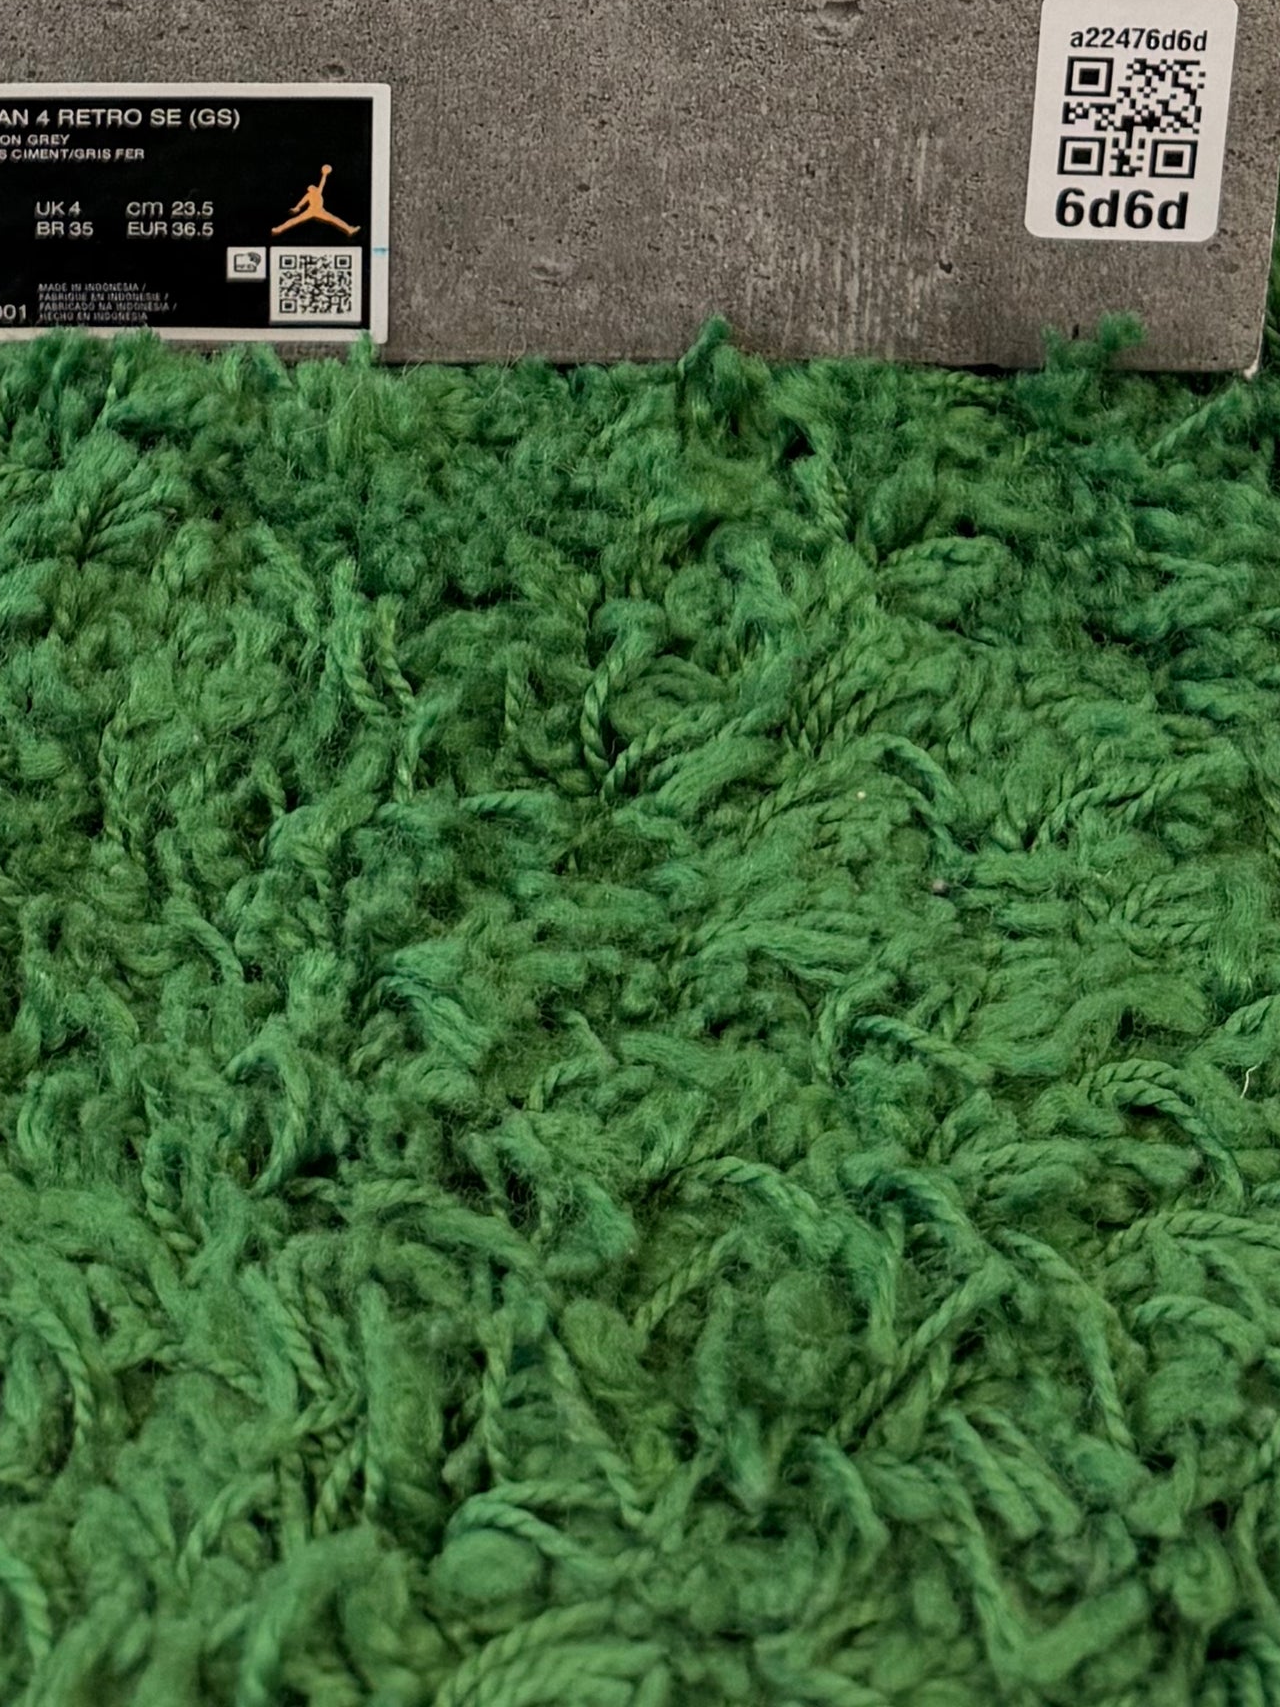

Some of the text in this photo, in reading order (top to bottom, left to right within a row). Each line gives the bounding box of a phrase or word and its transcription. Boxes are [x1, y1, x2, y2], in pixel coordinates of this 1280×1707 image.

[1070, 27, 1207, 51] a22476d6d
[36, 110, 50, 127] 4
[58, 109, 142, 127] RETRO
[150, 108, 182, 126] SE
[189, 108, 240, 129] (GS)
[28, 134, 70, 145] GREY
[12, 149, 111, 160] CIMENT/GRIS
[116, 148, 145, 159] FER
[36, 201, 81, 216] UK 4
[127, 201, 214, 216] cm 23.5
[1055, 187, 1189, 230] 6d6d
[36, 222, 94, 236] BR 35
[127, 222, 214, 237] EUR 36.5
[38, 283, 68, 291] MADE
[71, 283, 81, 291] IN
[85, 283, 139, 291] INDONESIA
